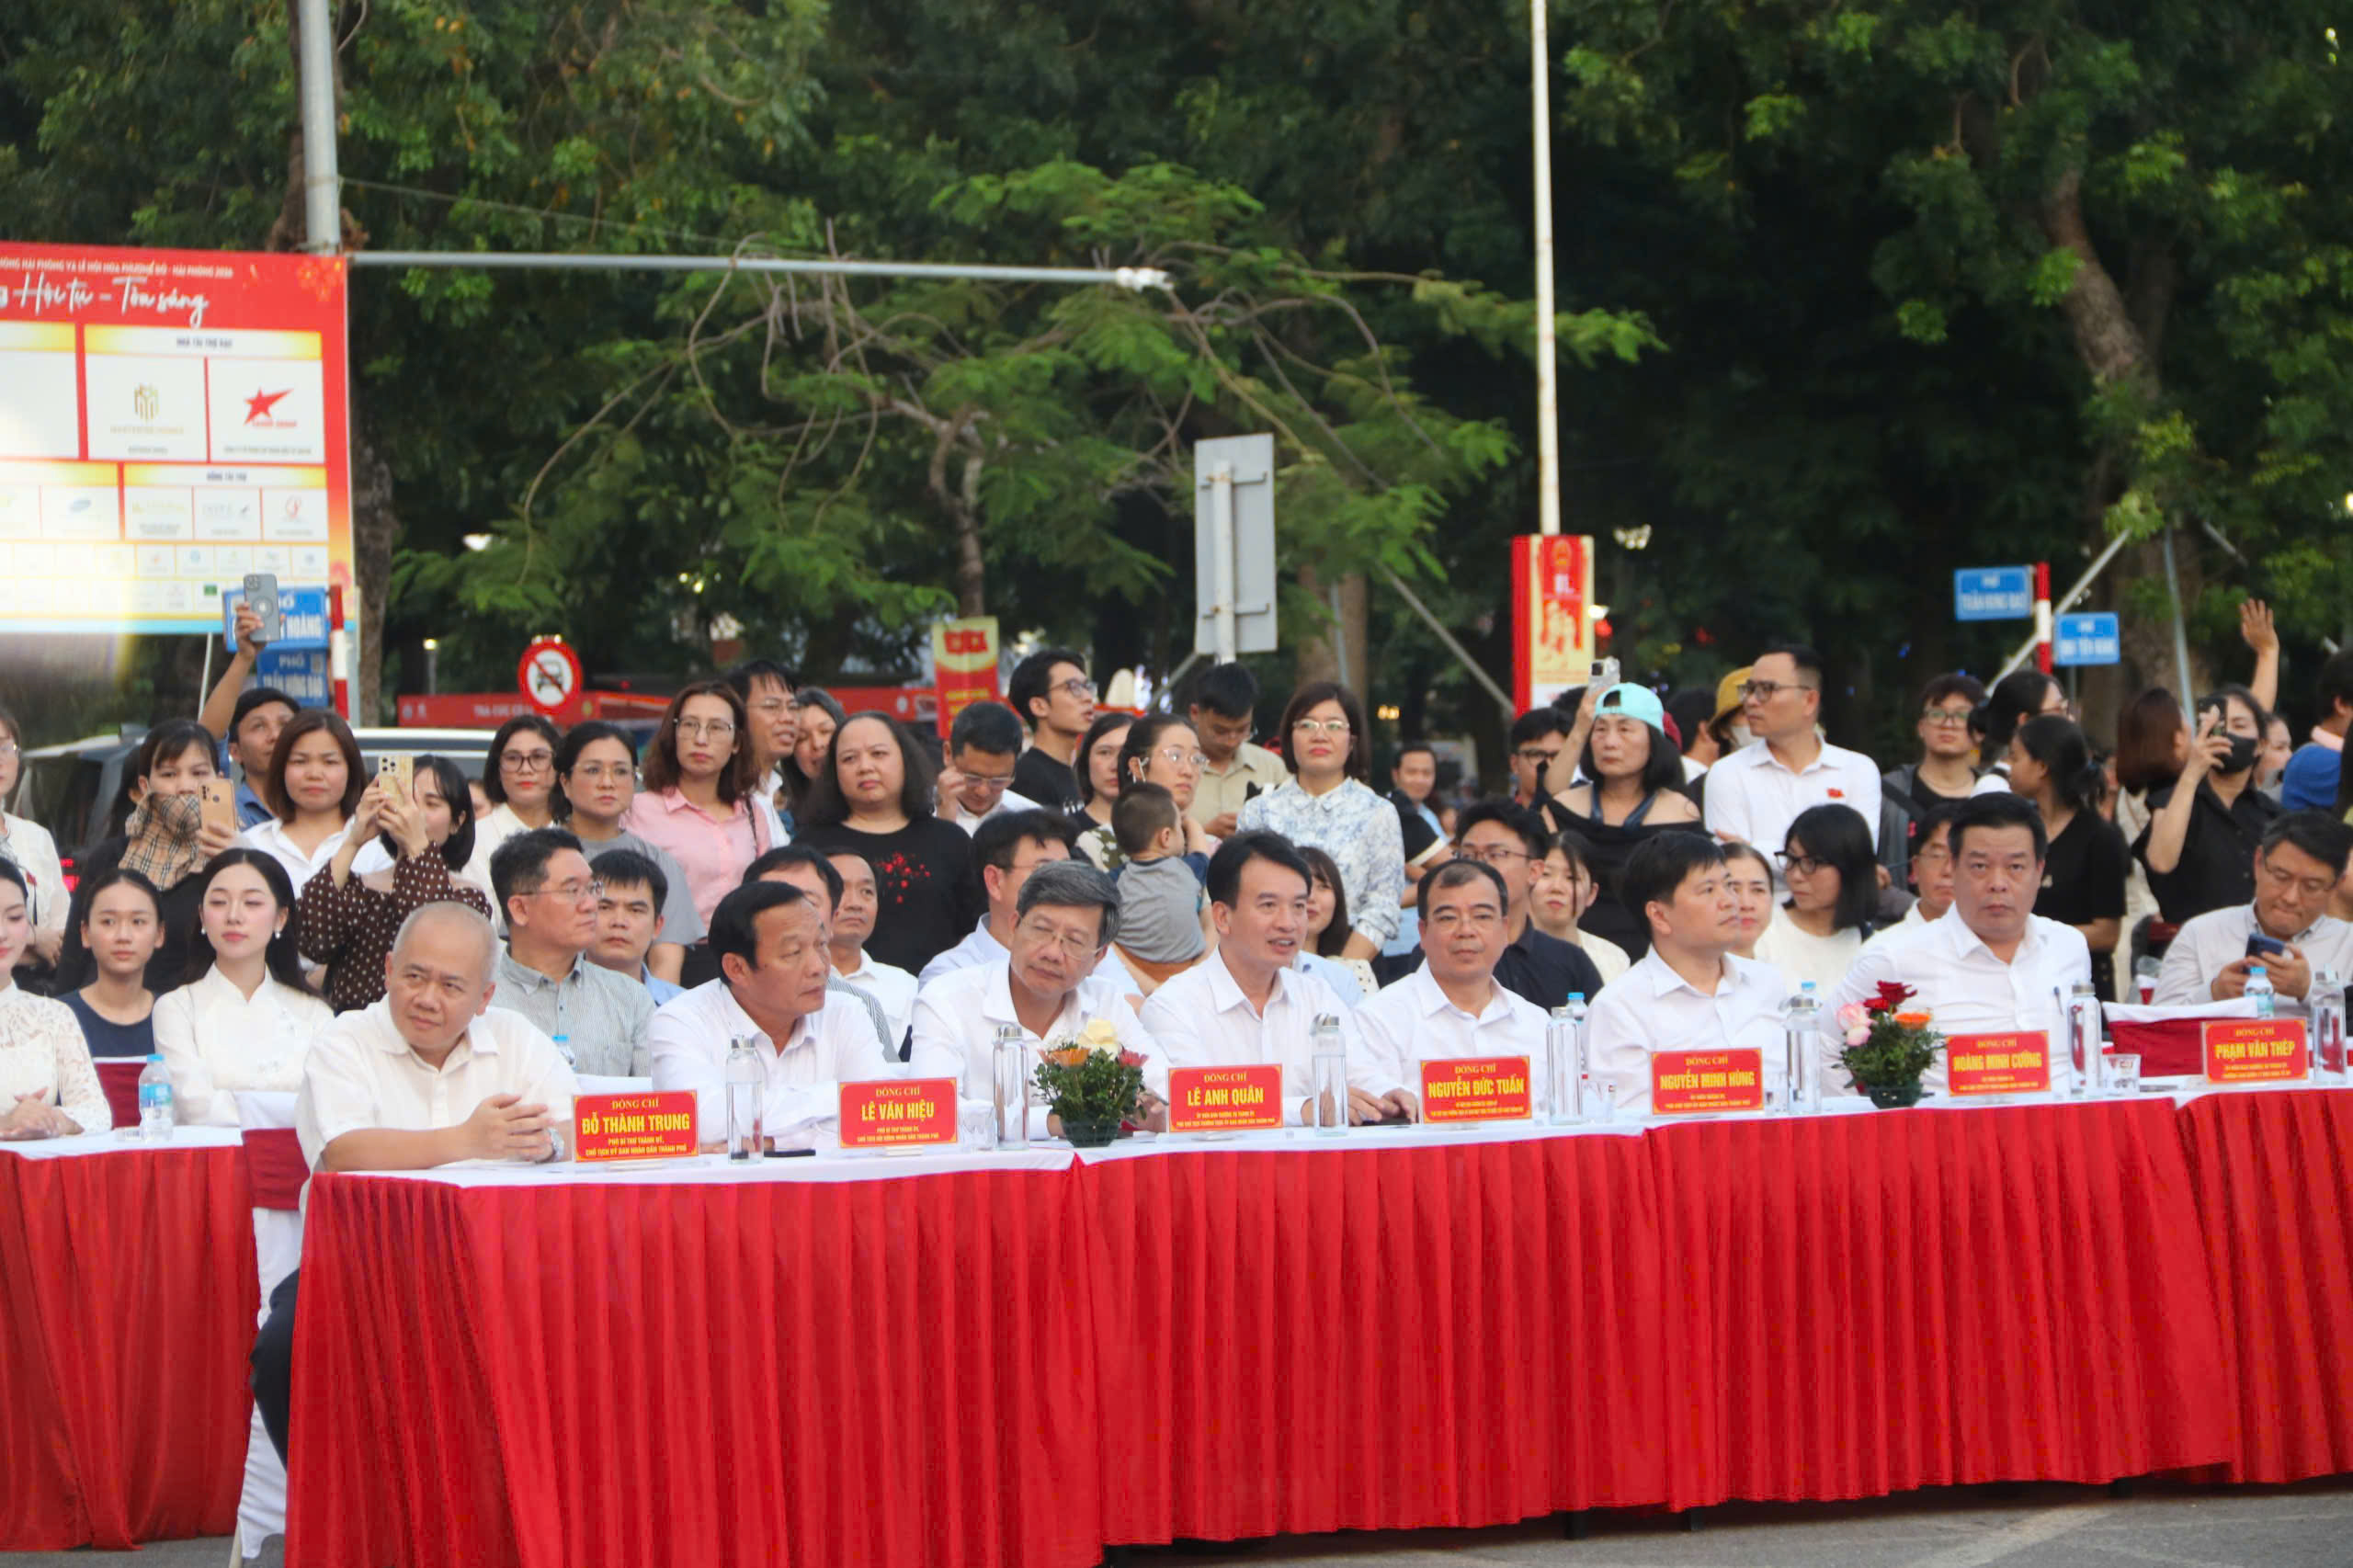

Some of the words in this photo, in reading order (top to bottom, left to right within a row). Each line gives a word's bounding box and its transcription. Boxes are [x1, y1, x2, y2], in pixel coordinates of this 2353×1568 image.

[2214, 1042, 2245, 1062] PHẠM
[2248, 1039, 2268, 1058] VĂN
[2270, 1038, 2295, 1056] THÉP
[1427, 1074, 1471, 1098] NGUYỄN
[1472, 1076, 1494, 1096] ĐỨC
[1496, 1073, 1525, 1094] TUẤN
[1660, 1067, 1699, 1089] NGUYỄN
[611, 1098, 640, 1109] ĐỒNG
[641, 1096, 659, 1108] CHÍ
[875, 1085, 902, 1097] ĐỒNG
[904, 1085, 920, 1096] CHÍ
[1188, 1085, 1201, 1107] LÊ
[1204, 1088, 1229, 1106] ANH
[1232, 1084, 1264, 1106] QUÂN
[861, 1100, 876, 1121] LÊ
[879, 1099, 904, 1120] VĂN
[906, 1097, 935, 1122] HIỆU
[582, 1110, 599, 1135] ĐỖ
[603, 1112, 644, 1133] THÀNH
[648, 1113, 690, 1131] TRUNG
